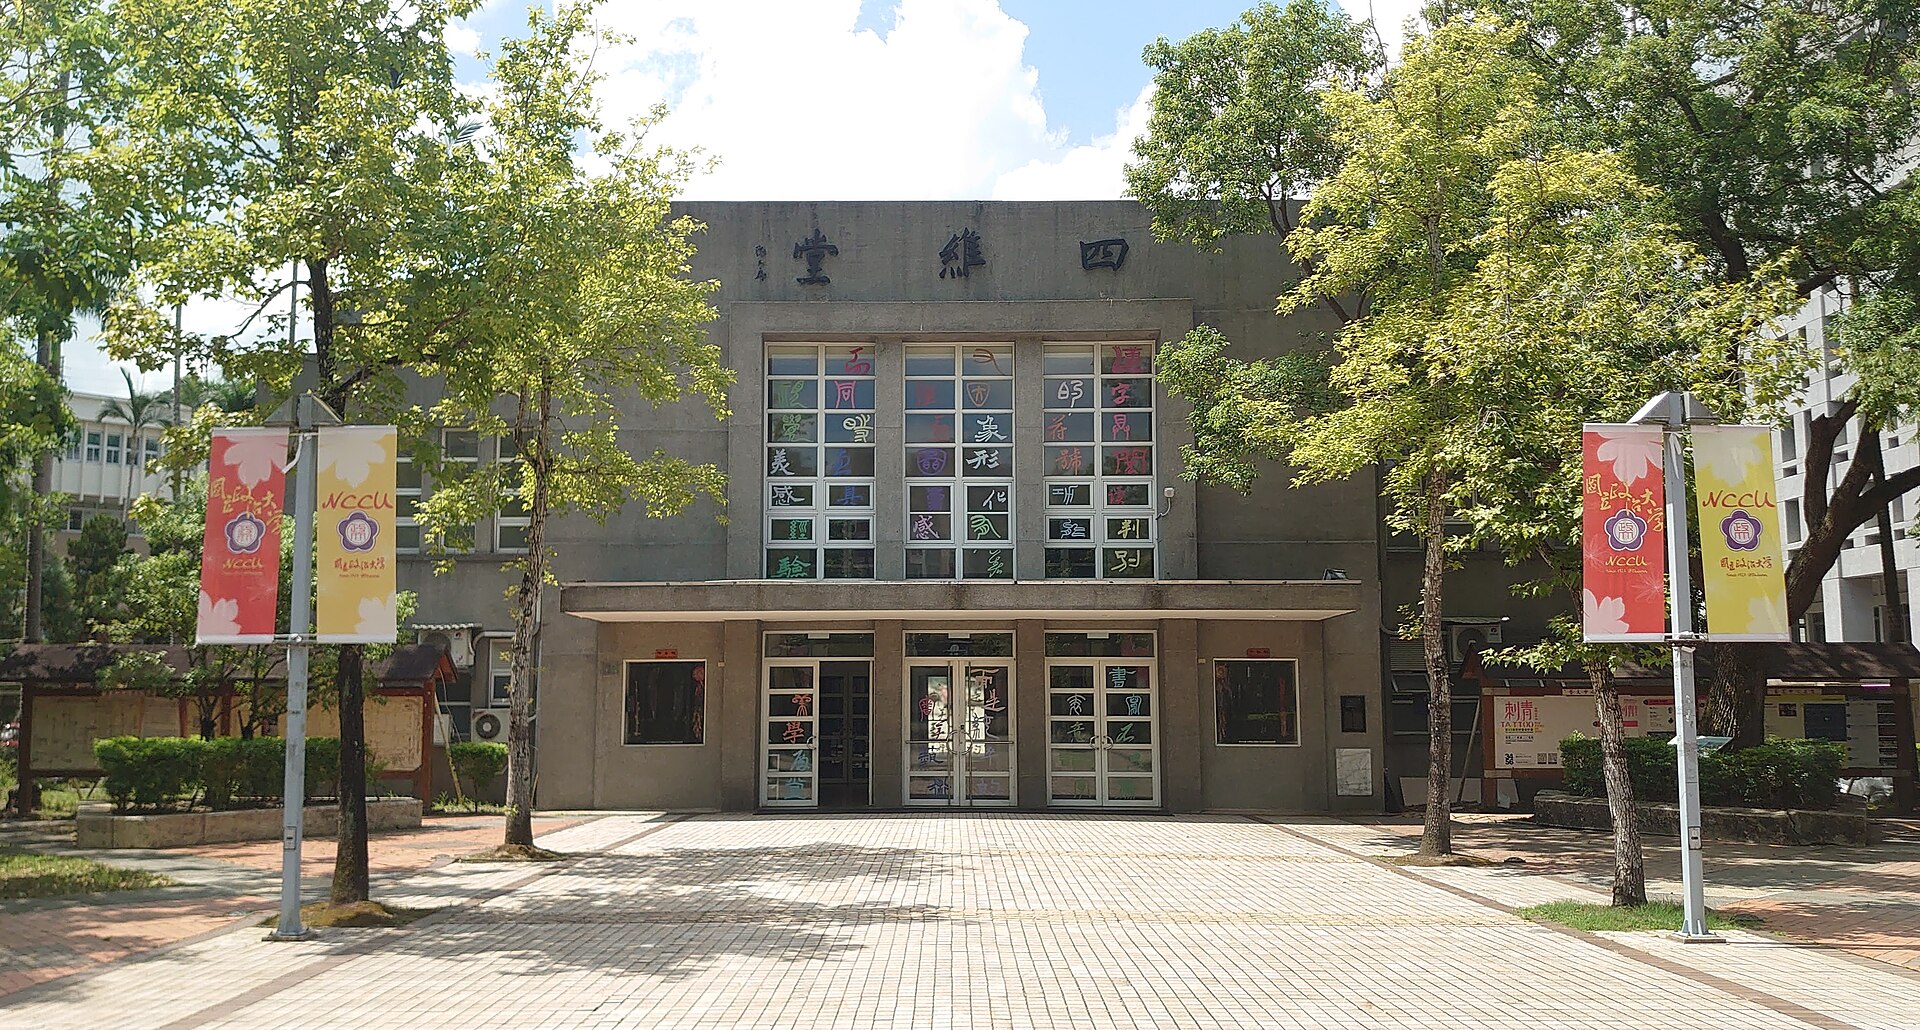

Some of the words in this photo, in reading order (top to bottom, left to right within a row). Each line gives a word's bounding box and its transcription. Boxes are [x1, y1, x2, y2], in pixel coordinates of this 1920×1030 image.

[792, 227, 1130, 286] 四維堂
[322, 491, 394, 510] NCCU
[1702, 490, 1776, 508] NCCU
[223, 557, 264, 569] NCCU
[1605, 555, 1648, 566] NCCU
[1505, 700, 1533, 721] 刺青
